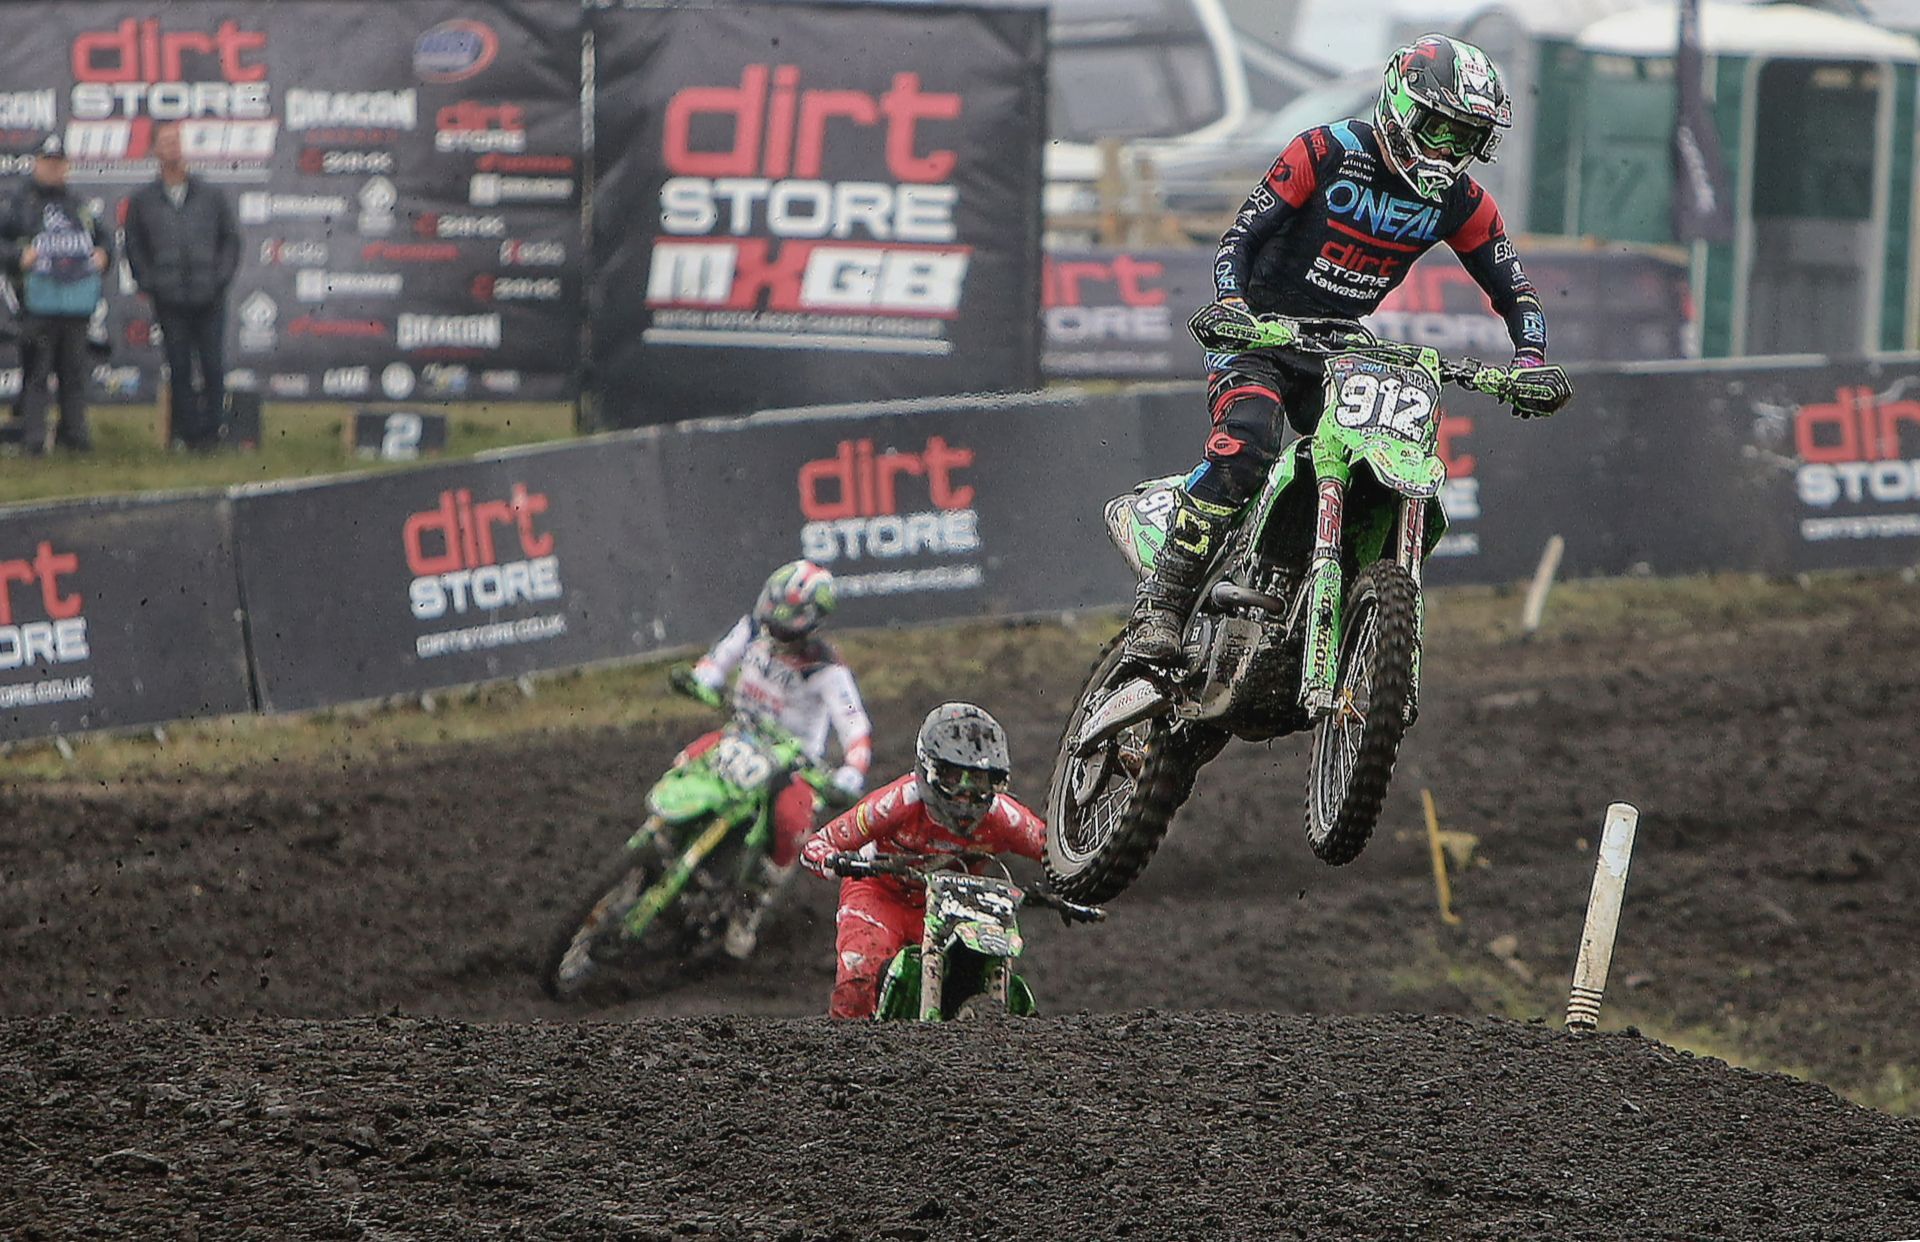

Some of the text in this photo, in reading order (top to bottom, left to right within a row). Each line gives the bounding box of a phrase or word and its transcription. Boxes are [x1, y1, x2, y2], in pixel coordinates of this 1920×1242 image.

[72, 17, 268, 83] dirt
[71, 81, 272, 120] STORE
[663, 63, 962, 183] dirt
[660, 176, 959, 242] STORE
[646, 239, 973, 318] MXGB
[1043, 255, 1168, 309] irt
[1305, 268, 1380, 300] Kawasaki
[1313, 256, 1390, 288] STORE
[1320, 241, 1399, 276] dirt
[381, 412, 423, 461] 2
[1335, 373, 1433, 442] 912
[1796, 385, 1920, 463] dir
[798, 435, 976, 521] dirt
[1797, 458, 1920, 505] STO
[403, 482, 556, 577] dirt
[800, 508, 982, 564] STORE
[0, 540, 84, 626] rt
[408, 554, 563, 620] STORE
[0, 616, 91, 669] ORE
